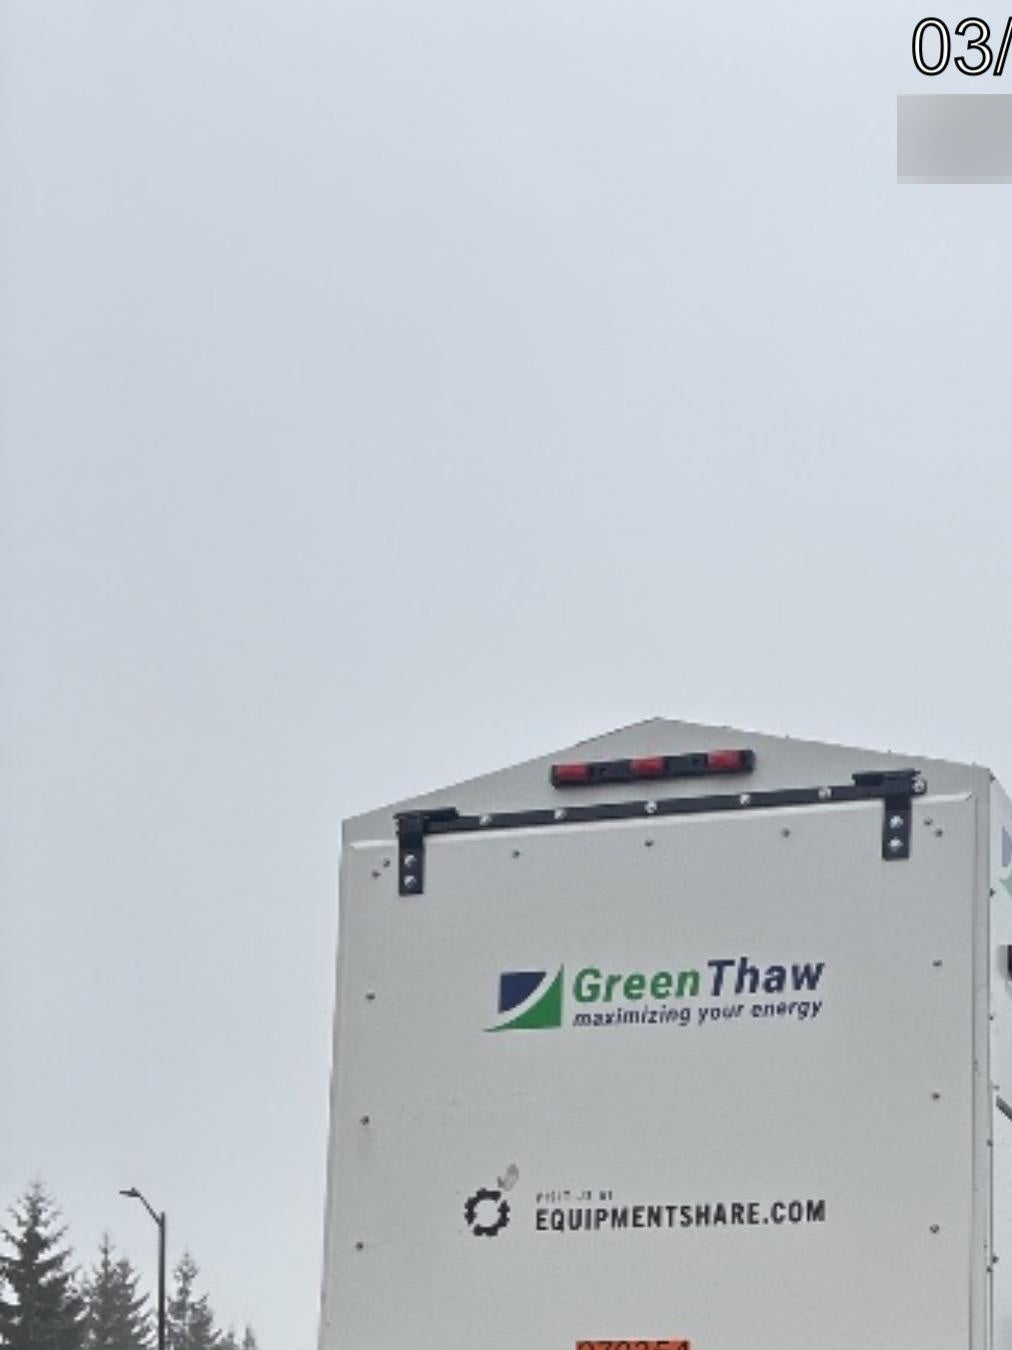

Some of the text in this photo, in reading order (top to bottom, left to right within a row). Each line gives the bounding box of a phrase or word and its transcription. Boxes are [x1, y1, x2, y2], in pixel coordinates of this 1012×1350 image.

[572, 999, 823, 1027] maximizing your energy
[535, 1199, 827, 1233] EQUIPMENTSHARE.COM
